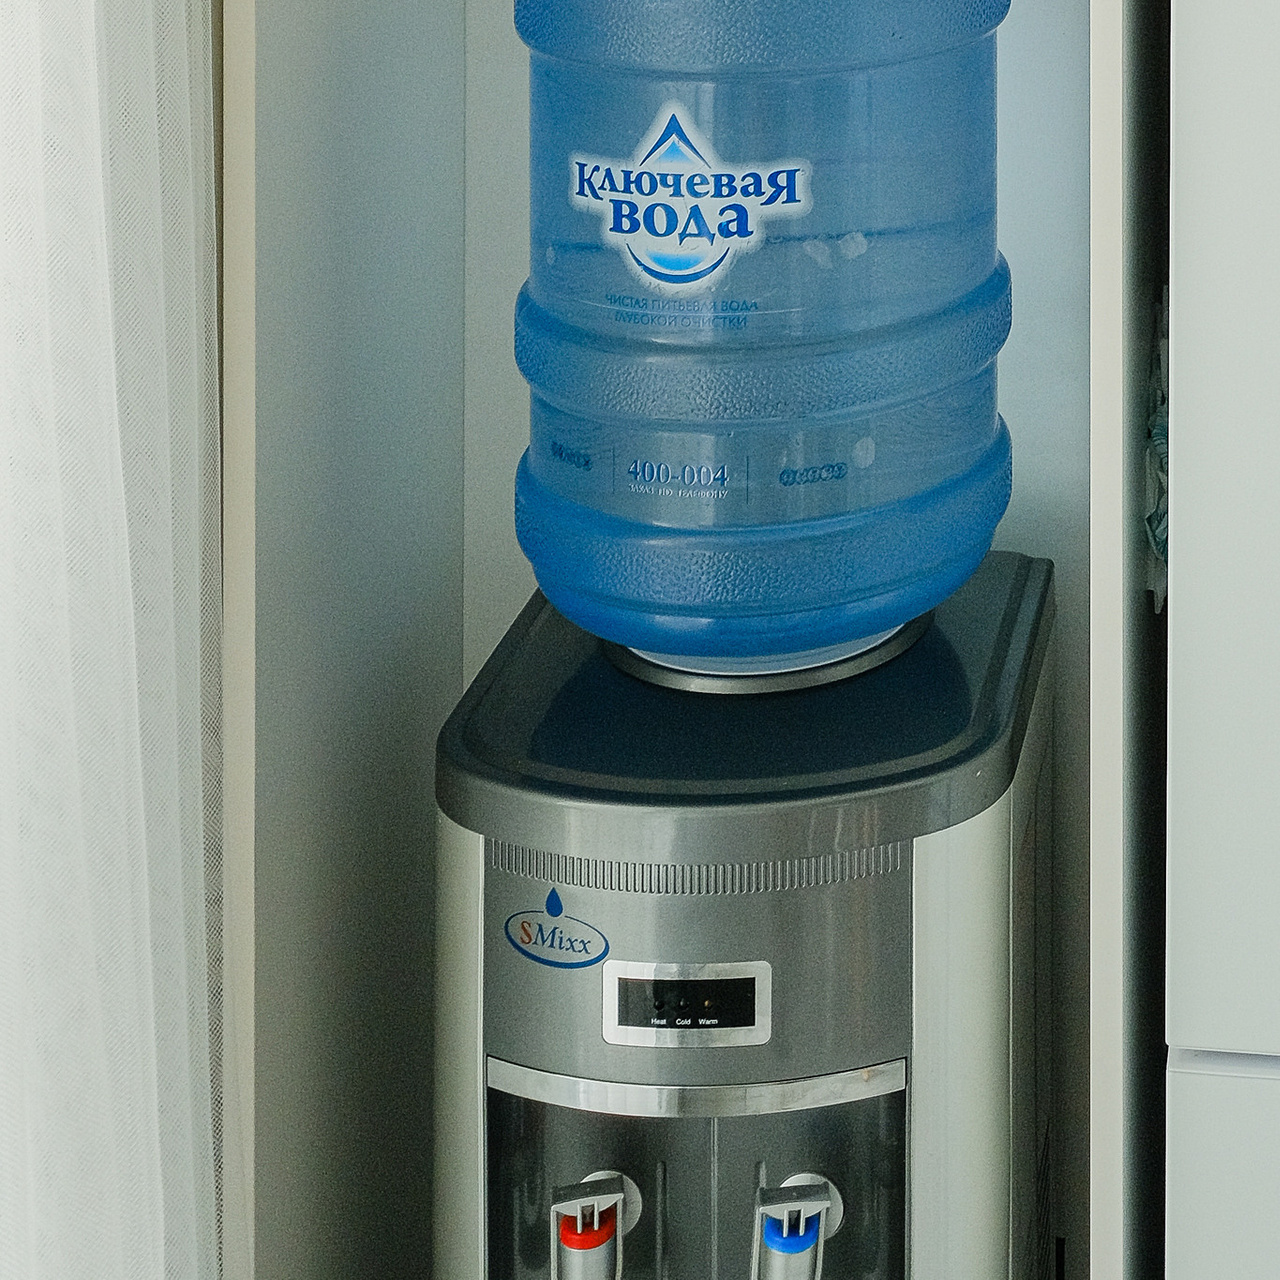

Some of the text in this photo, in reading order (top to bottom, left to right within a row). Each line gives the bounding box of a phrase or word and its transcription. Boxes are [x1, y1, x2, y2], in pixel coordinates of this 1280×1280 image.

[605, 293, 648, 310] ЧИСТАЯ
[720, 300, 758, 312] ВОДА
[614, 311, 747, 329] ГЛУБОКОЙ ОЧИСТКИ
[627, 459, 730, 488] 400-004
[520, 920, 591, 954] SMixx
